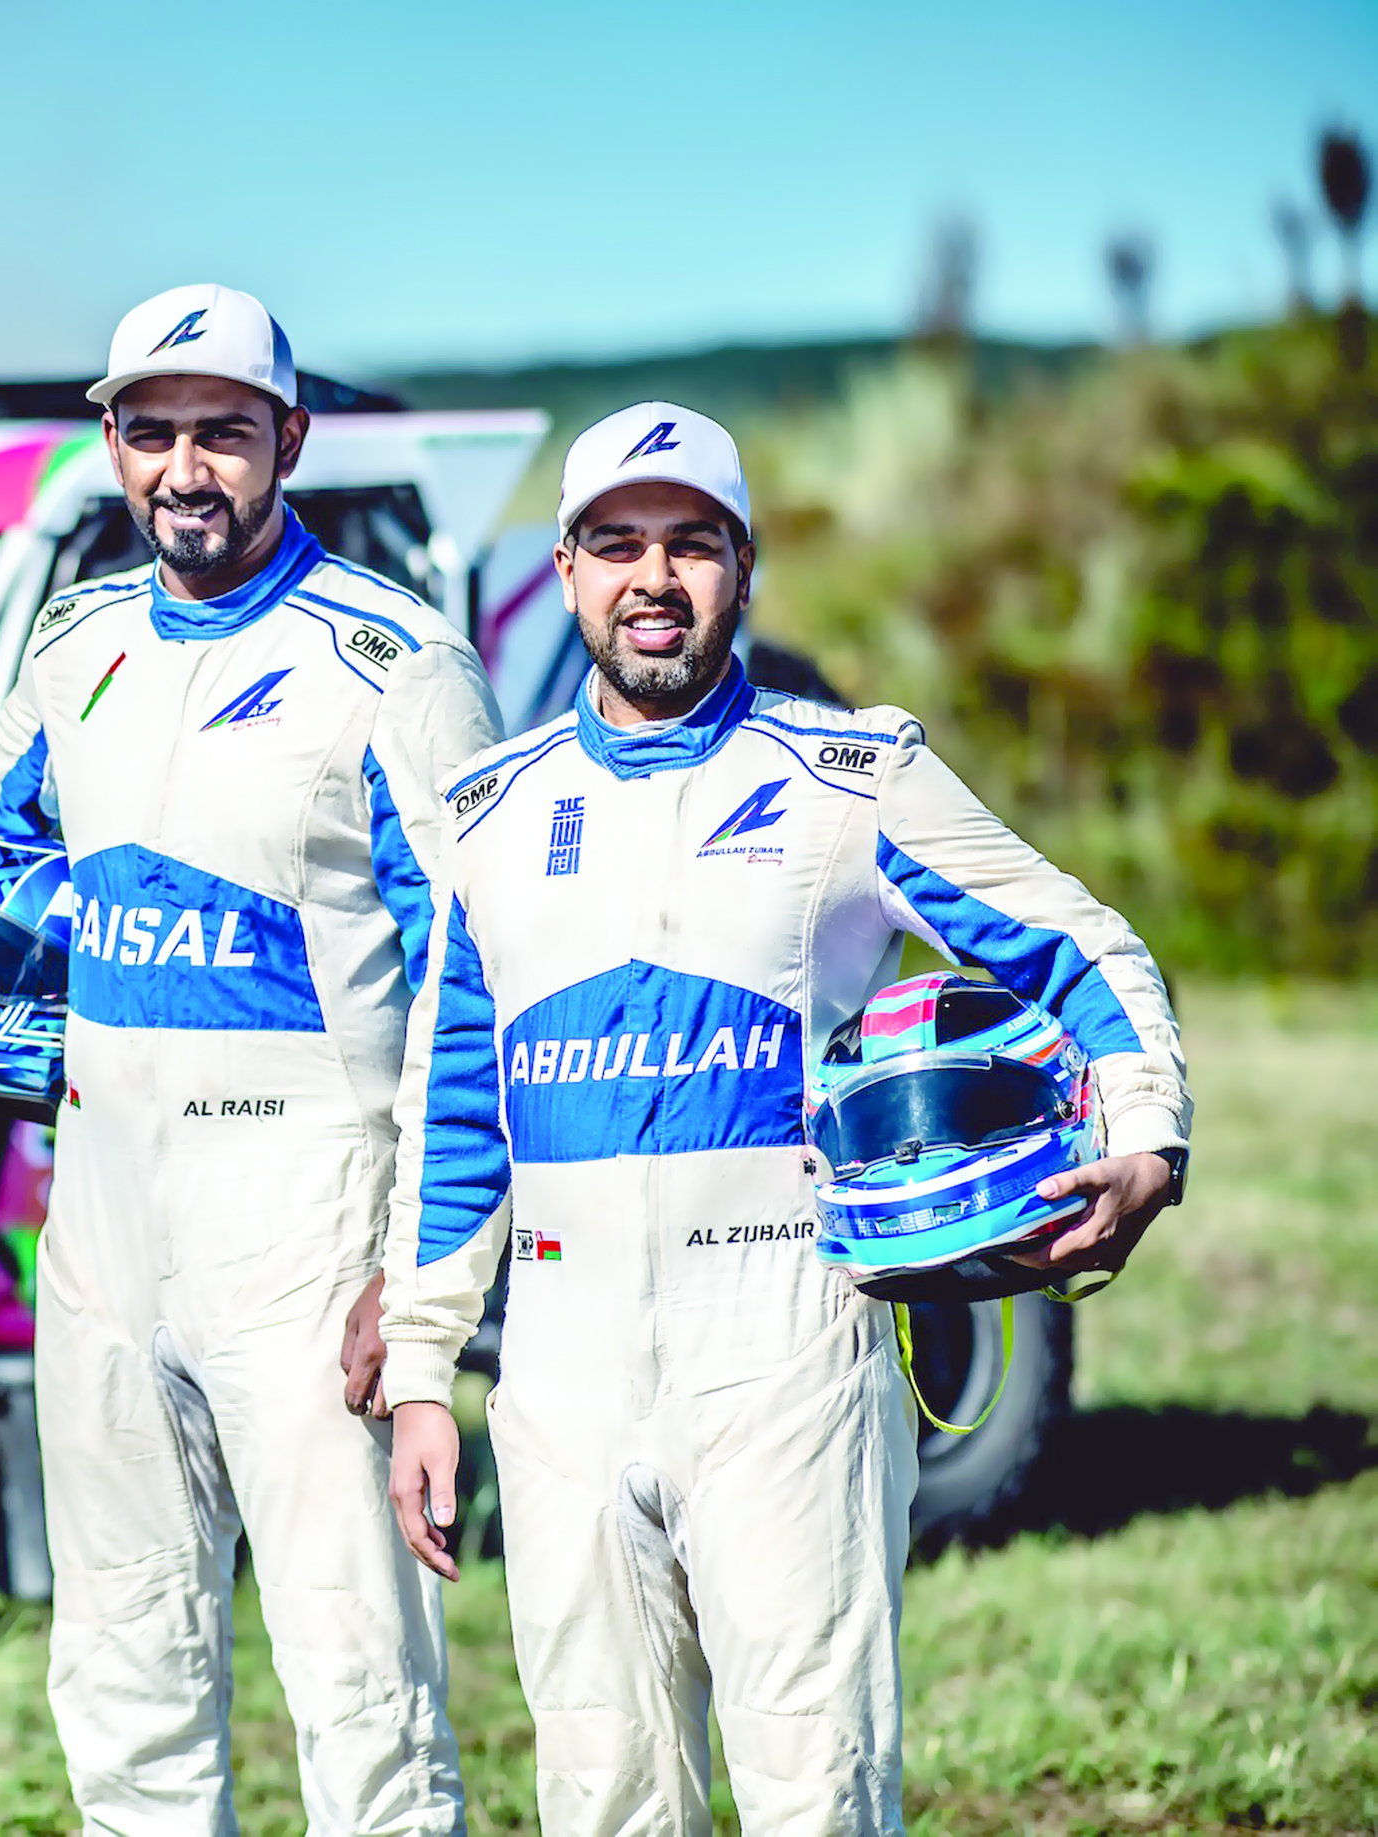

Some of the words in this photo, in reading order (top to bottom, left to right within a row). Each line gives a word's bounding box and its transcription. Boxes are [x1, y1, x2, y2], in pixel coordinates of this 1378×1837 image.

[41, 602, 76, 628] OMP
[351, 629, 398, 662] OMP
[818, 746, 877, 769] OMP
[456, 777, 498, 814] OMP
[510, 1023, 785, 1087] ABDULLAH
[183, 1100, 213, 1117] AL
[221, 1099, 285, 1117] RAISI
[686, 1228, 720, 1247] AL
[726, 1222, 815, 1244] ZUBAIR
